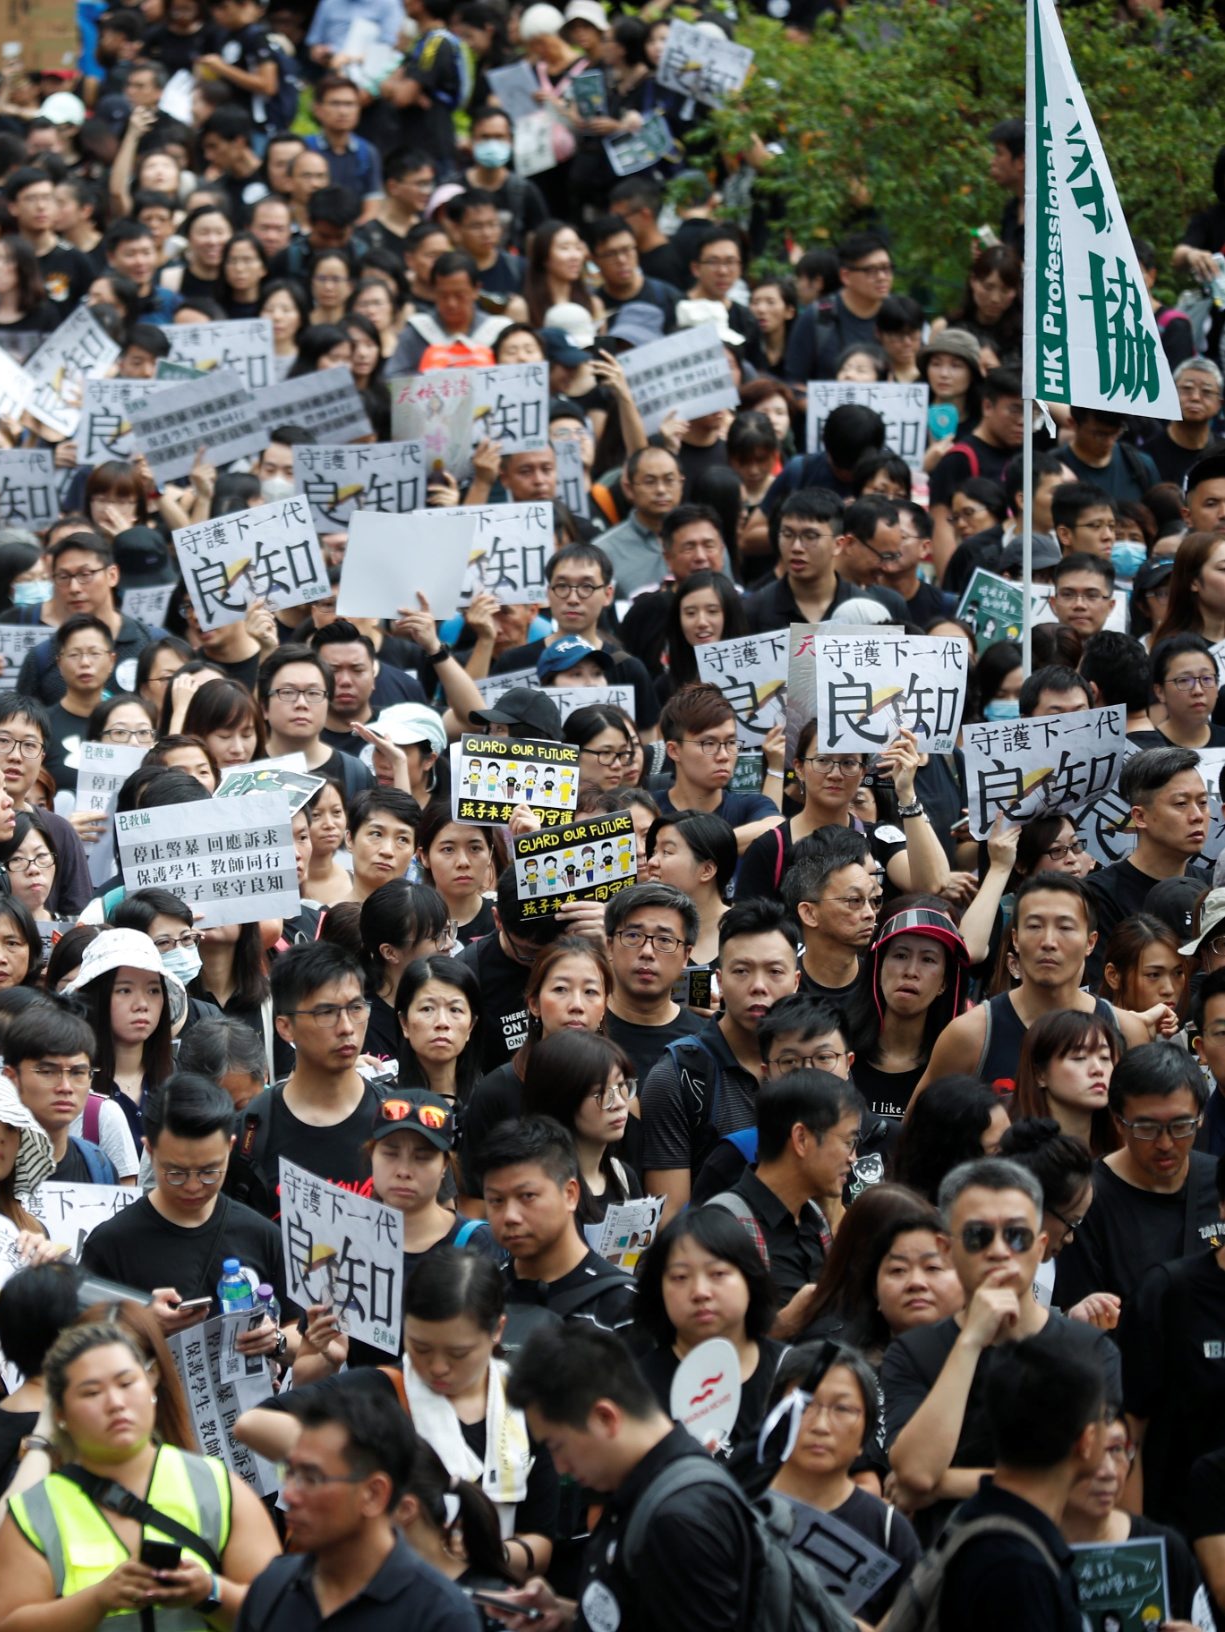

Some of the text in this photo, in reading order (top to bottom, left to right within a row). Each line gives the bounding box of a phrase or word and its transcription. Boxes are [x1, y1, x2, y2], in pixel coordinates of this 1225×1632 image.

[1041, 139, 1064, 336] Professional
[1044, 344, 1065, 395] HK
[490, 394, 542, 442] 知
[814, 386, 924, 409] 守護下一代
[297, 444, 423, 471] 守護下一代
[303, 472, 420, 528] 良知
[179, 501, 308, 555] 守護下一代
[191, 539, 319, 625] 良知
[485, 536, 546, 591] 知
[822, 638, 964, 671] 守護下一代
[826, 671, 960, 749] 良知
[969, 710, 1121, 757] 守護下一代
[466, 738, 579, 762] GUARD OUR FUTURE
[977, 750, 1118, 836] 良知
[132, 828, 279, 864] 停止警暴 回應訴求
[518, 816, 632, 854] GUARD OUR FUTURE
[136, 851, 281, 887] 保護學生 教師同行
[212, 874, 284, 898] 堅守良知
[499, 1009, 527, 1025] THERE
[502, 1021, 523, 1036] ON
[871, 1101, 877, 1112] I
[283, 1168, 398, 1250] 守護下一代
[287, 1212, 396, 1328] 良知
[184, 1340, 211, 1416] 保護學生
